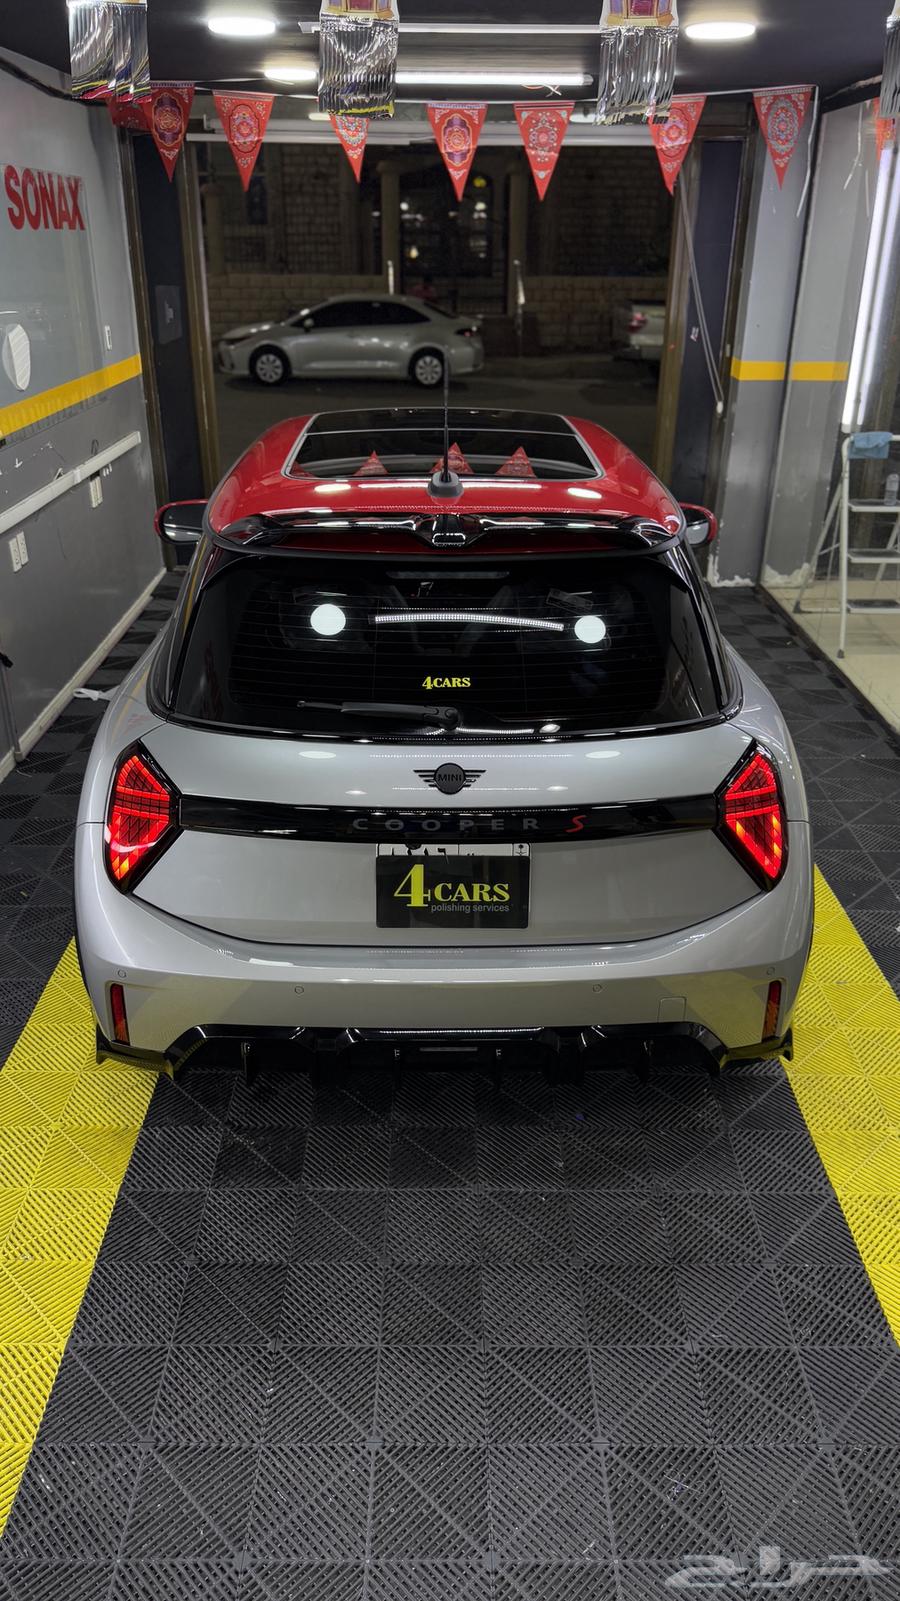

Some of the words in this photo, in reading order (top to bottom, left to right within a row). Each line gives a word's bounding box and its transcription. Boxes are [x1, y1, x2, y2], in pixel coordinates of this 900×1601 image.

[4, 164, 86, 231] SONAX
[437, 773, 462, 782] MINI
[352, 817, 540, 832] COOPER
[563, 814, 588, 833] S
[431, 903, 471, 914] polishing
[472, 904, 510, 913] services
